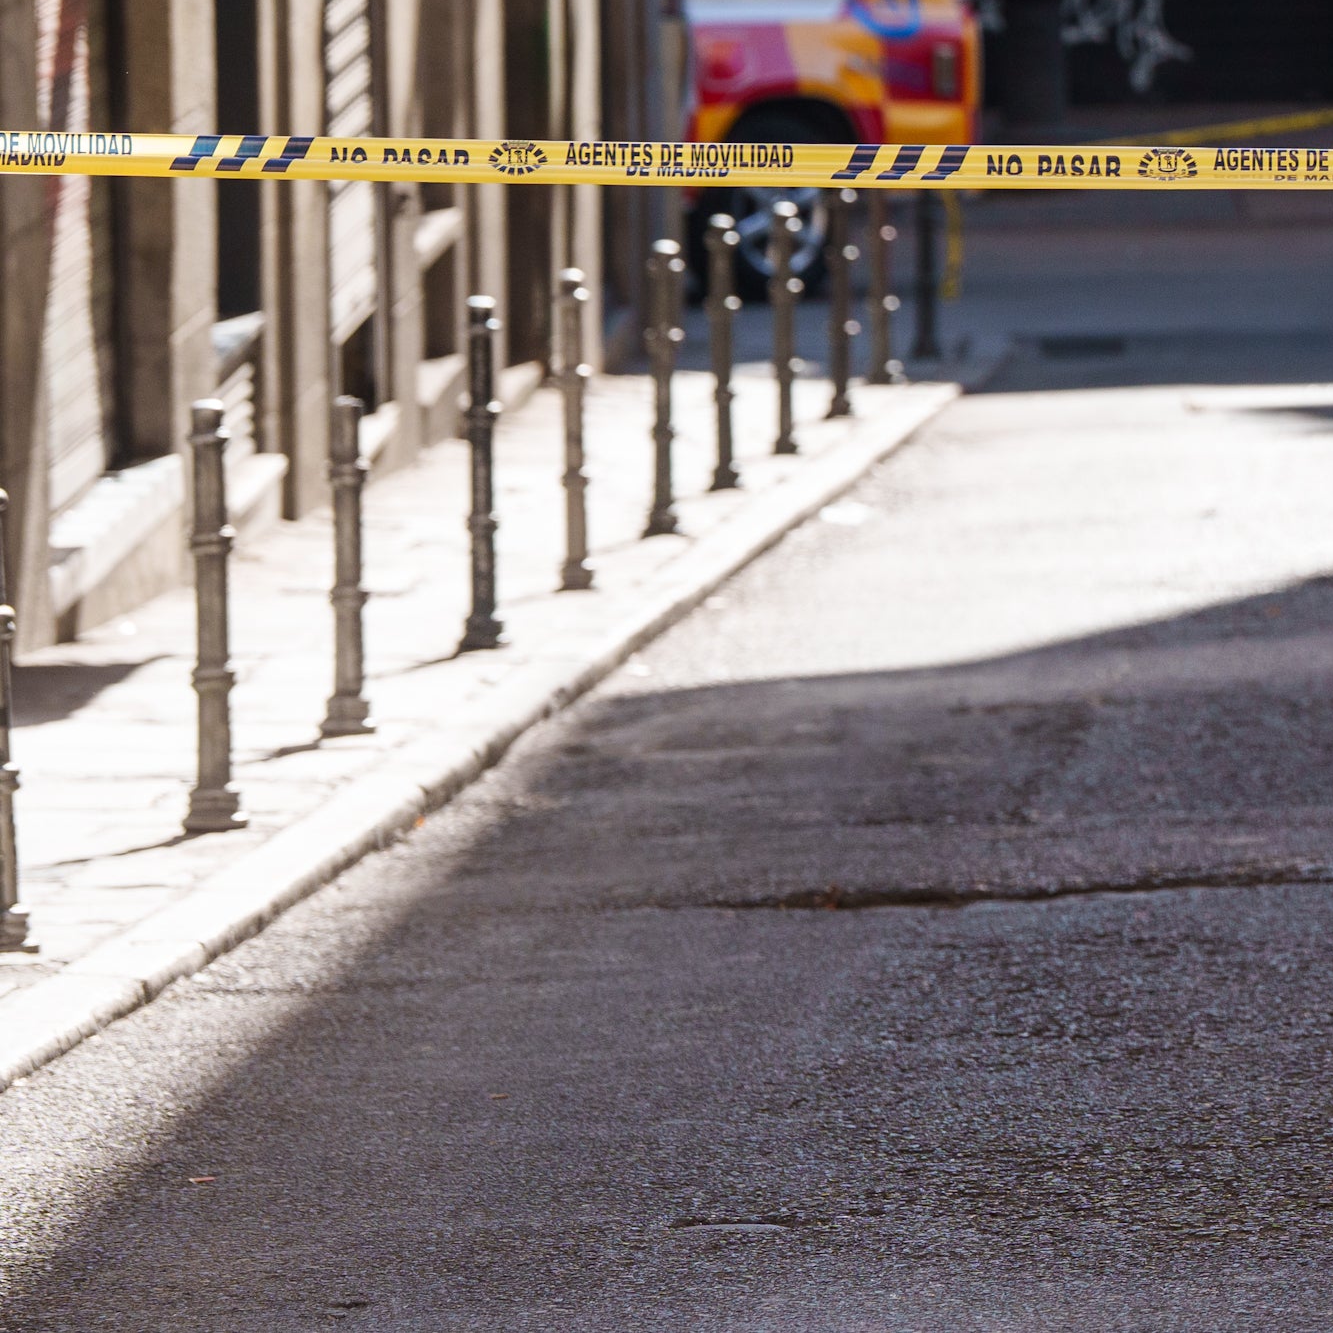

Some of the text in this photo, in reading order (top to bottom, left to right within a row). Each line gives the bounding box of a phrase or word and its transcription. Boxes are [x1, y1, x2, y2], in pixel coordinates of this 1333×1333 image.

[28, 132, 133, 156] MOVILIDAD
[565, 142, 793, 168] AGENTES DE MOVILIDAD
[330, 147, 470, 166] NO PASAR
[987, 154, 1121, 177] NO PASAR
[1213, 149, 1299, 172] AGENTES
[1307, 149, 1329, 172] DE
